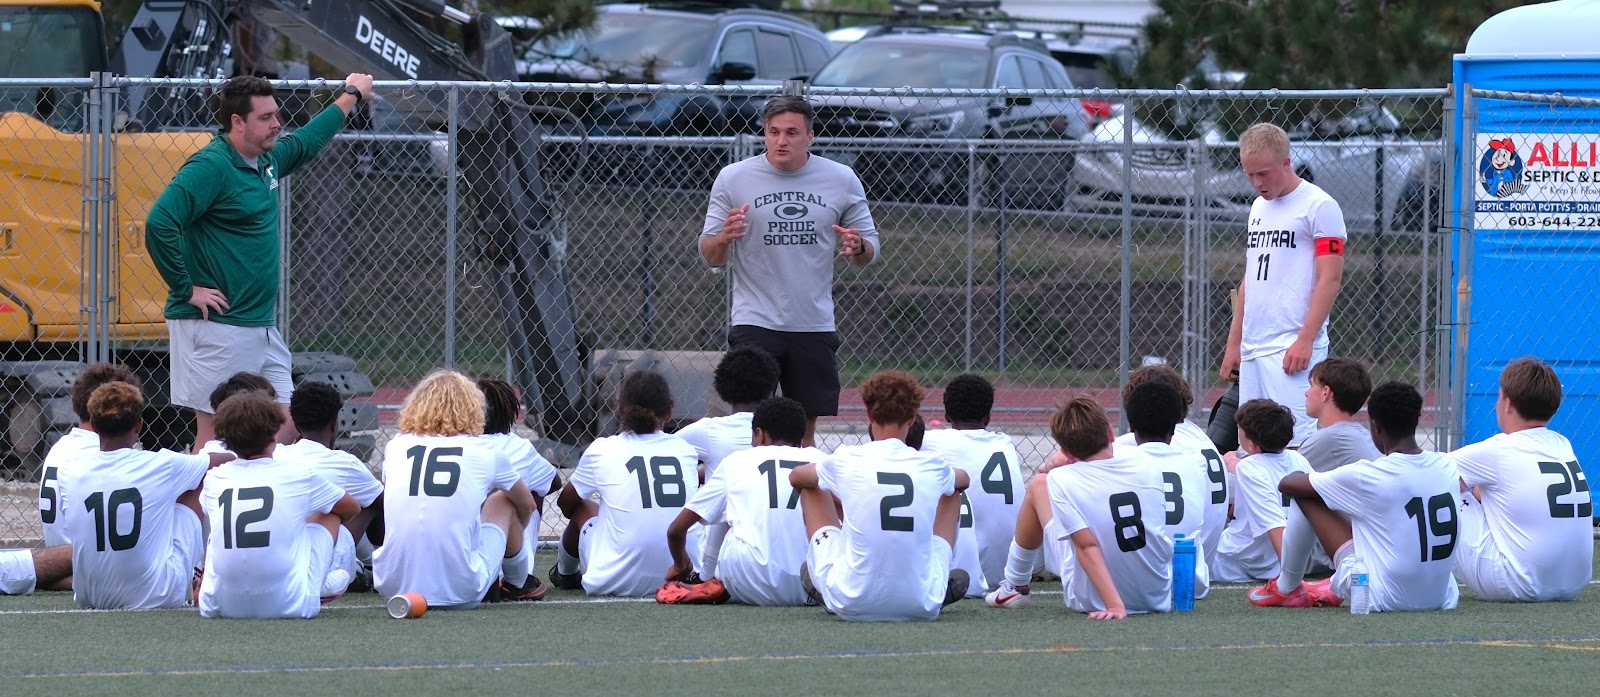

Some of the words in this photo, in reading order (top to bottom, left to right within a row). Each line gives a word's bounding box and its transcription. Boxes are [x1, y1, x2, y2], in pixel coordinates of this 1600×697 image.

[355, 15, 421, 80] DEERE
[1524, 170, 1575, 183] SEPTIC
[1579, 170, 1590, 183] &
[1526, 142, 1597, 167] ALLI
[754, 191, 827, 209] CENTRAL
[767, 220, 815, 233] PRIDE
[1477, 202, 1504, 211] SEPTIC
[1509, 202, 1537, 211] PORTA
[1538, 203, 1571, 212] POTTYS
[763, 233, 818, 246] SOCCER
[1328, 239, 1340, 254] C
[1256, 253, 1270, 281] 11
[406, 444, 463, 497] 16
[625, 455, 687, 509] 18
[757, 459, 811, 510] 17
[980, 451, 1014, 505] 4
[1537, 459, 1593, 518] 25
[83, 486, 143, 552] 10
[217, 486, 275, 550] 12
[876, 471, 914, 532] 2
[1109, 491, 1147, 553] 8
[1404, 492, 1458, 563] 19
